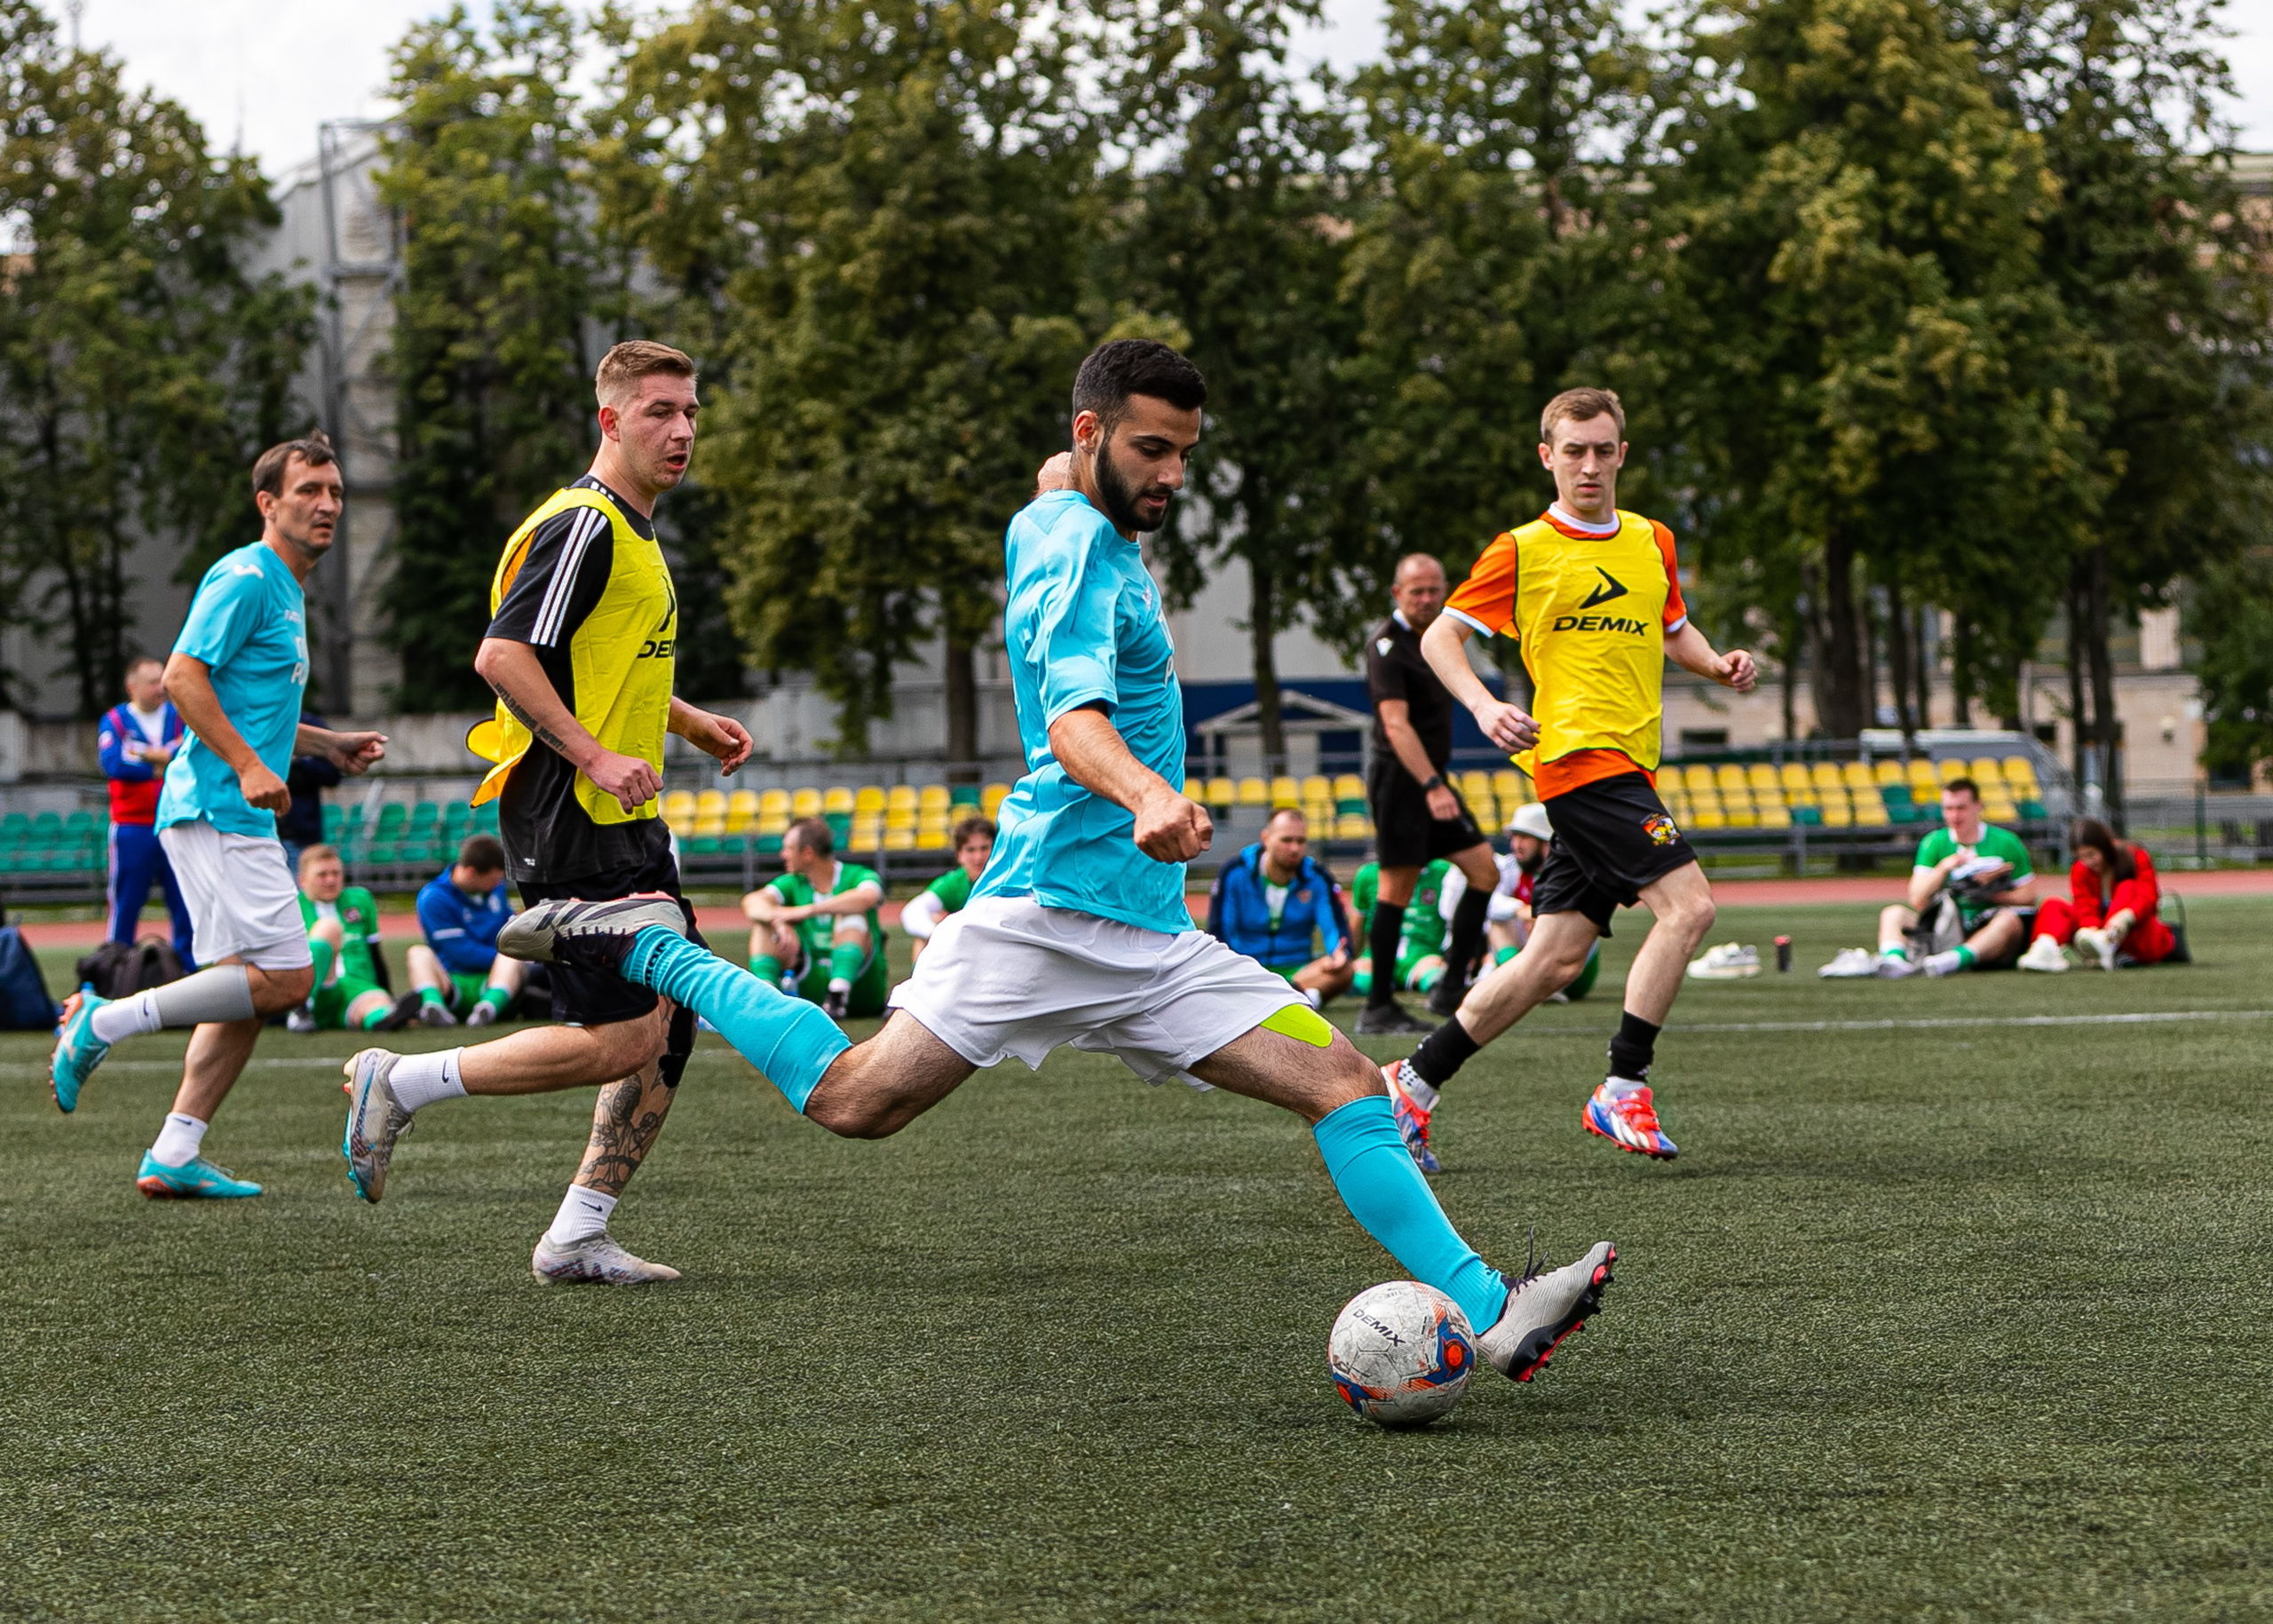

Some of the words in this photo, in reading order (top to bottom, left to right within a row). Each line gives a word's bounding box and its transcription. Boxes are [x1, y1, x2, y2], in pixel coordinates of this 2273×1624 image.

[1552, 615, 1650, 637] DEMIX
[637, 639, 676, 659] DE
[1352, 1308, 1406, 1348] DEMIX
